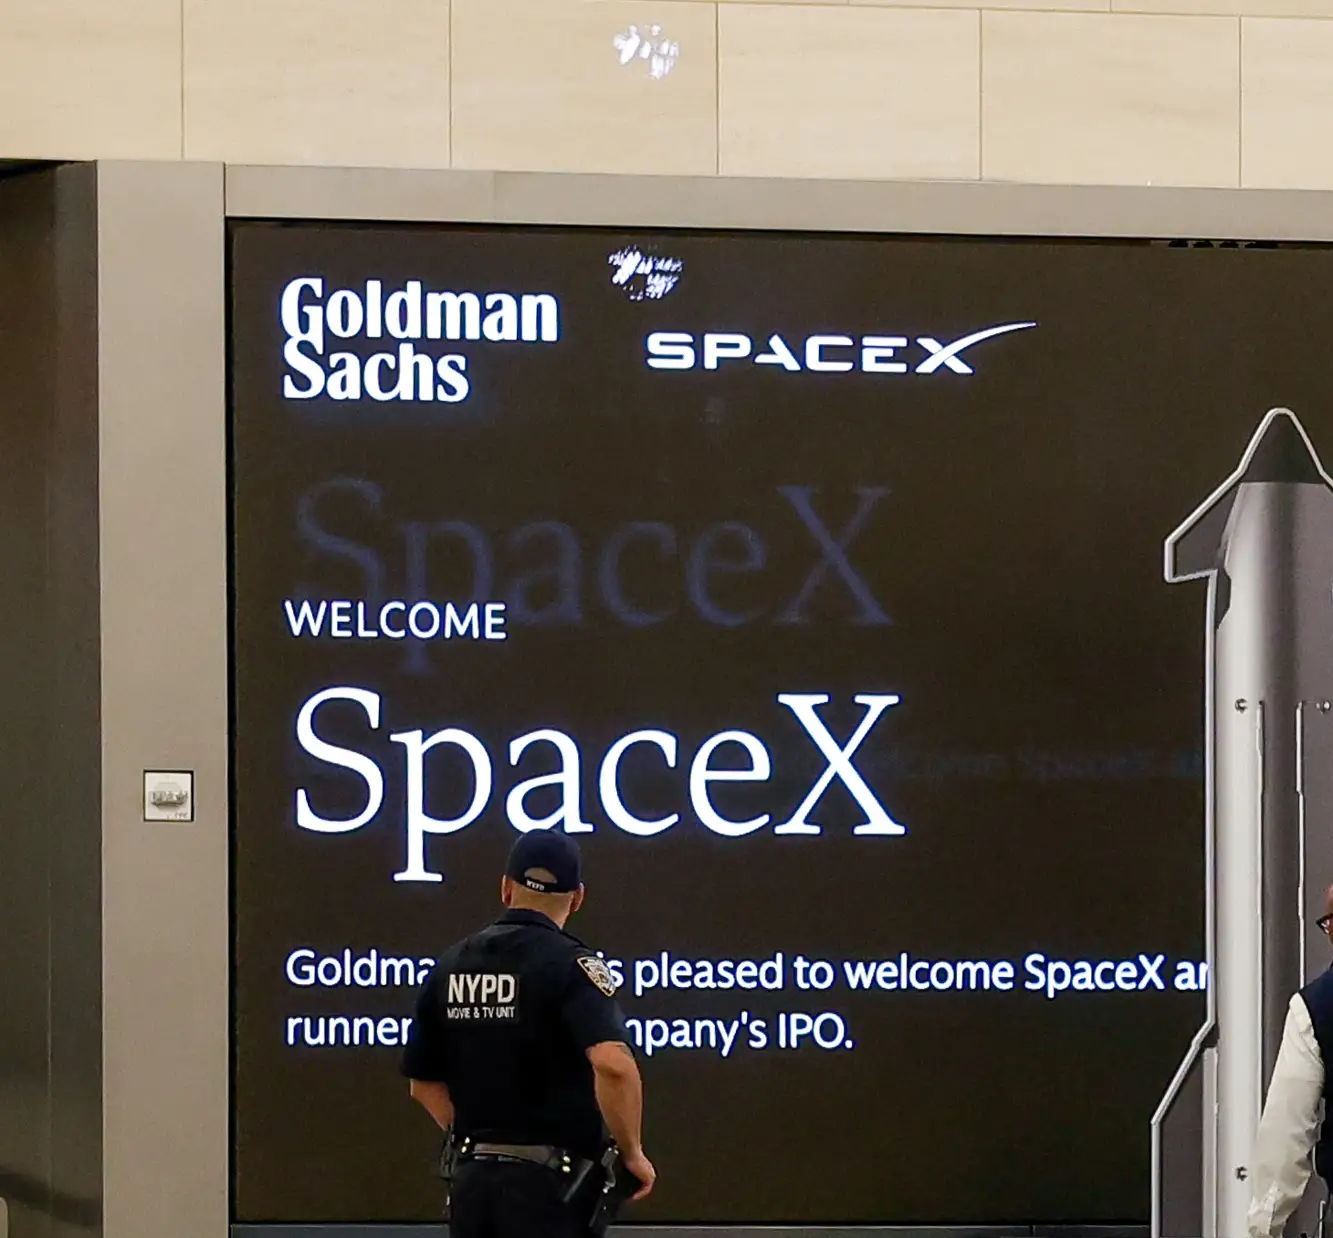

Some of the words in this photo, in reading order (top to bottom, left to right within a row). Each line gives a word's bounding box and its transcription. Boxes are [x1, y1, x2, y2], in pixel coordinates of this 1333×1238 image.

[280, 277, 558, 344] Goldman
[283, 338, 471, 403] Sachs
[646, 322, 1037, 374] SPACEX
[284, 600, 506, 639] WELCOME
[296, 686, 905, 883] SpaceX
[447, 973, 516, 1004] NYPD
[635, 951, 783, 997] pleased
[793, 956, 834, 989] to
[843, 952, 1014, 990] welcome
[1024, 953, 1165, 999] SpaceX
[287, 1017, 413, 1046] runner
[778, 1012, 854, 1049] IPO.
[473, 1006, 480, 1019] &
[481, 1006, 495, 1019] TV
